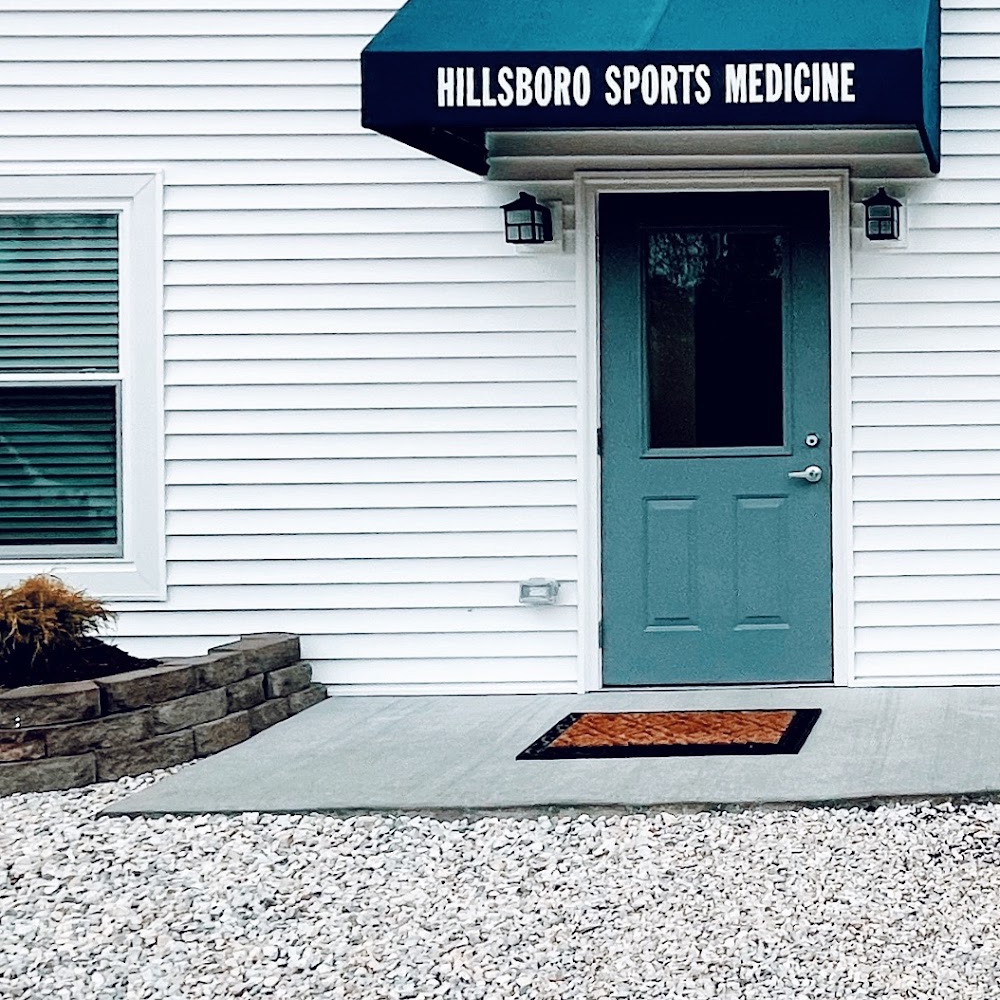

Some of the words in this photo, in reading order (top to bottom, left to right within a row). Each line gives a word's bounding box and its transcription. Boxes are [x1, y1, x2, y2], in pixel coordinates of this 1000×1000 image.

[437, 65, 591, 107] HILLSBORO
[604, 64, 711, 106] SPORTS
[725, 62, 856, 104] MEDICINE
